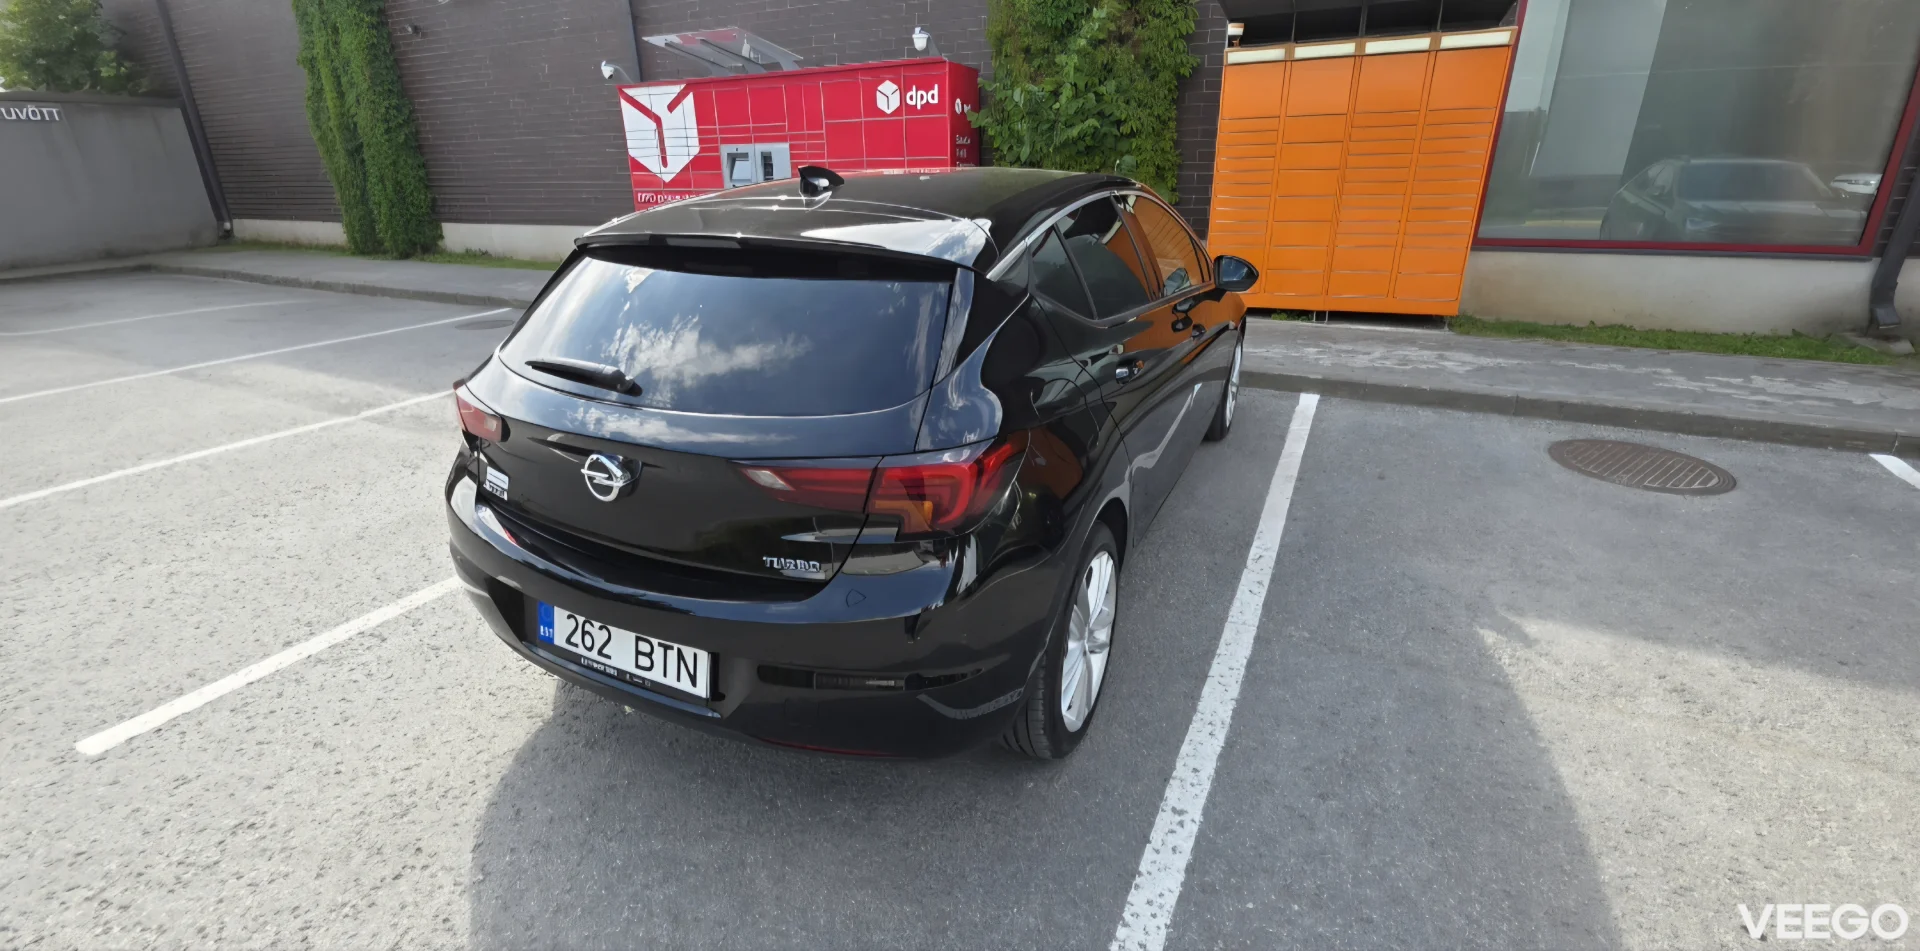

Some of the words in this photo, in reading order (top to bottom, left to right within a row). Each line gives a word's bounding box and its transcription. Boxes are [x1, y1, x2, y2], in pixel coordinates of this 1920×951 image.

[906, 83, 939, 110] dpd
[565, 613, 612, 660] 262
[634, 634, 698, 689] BTN
